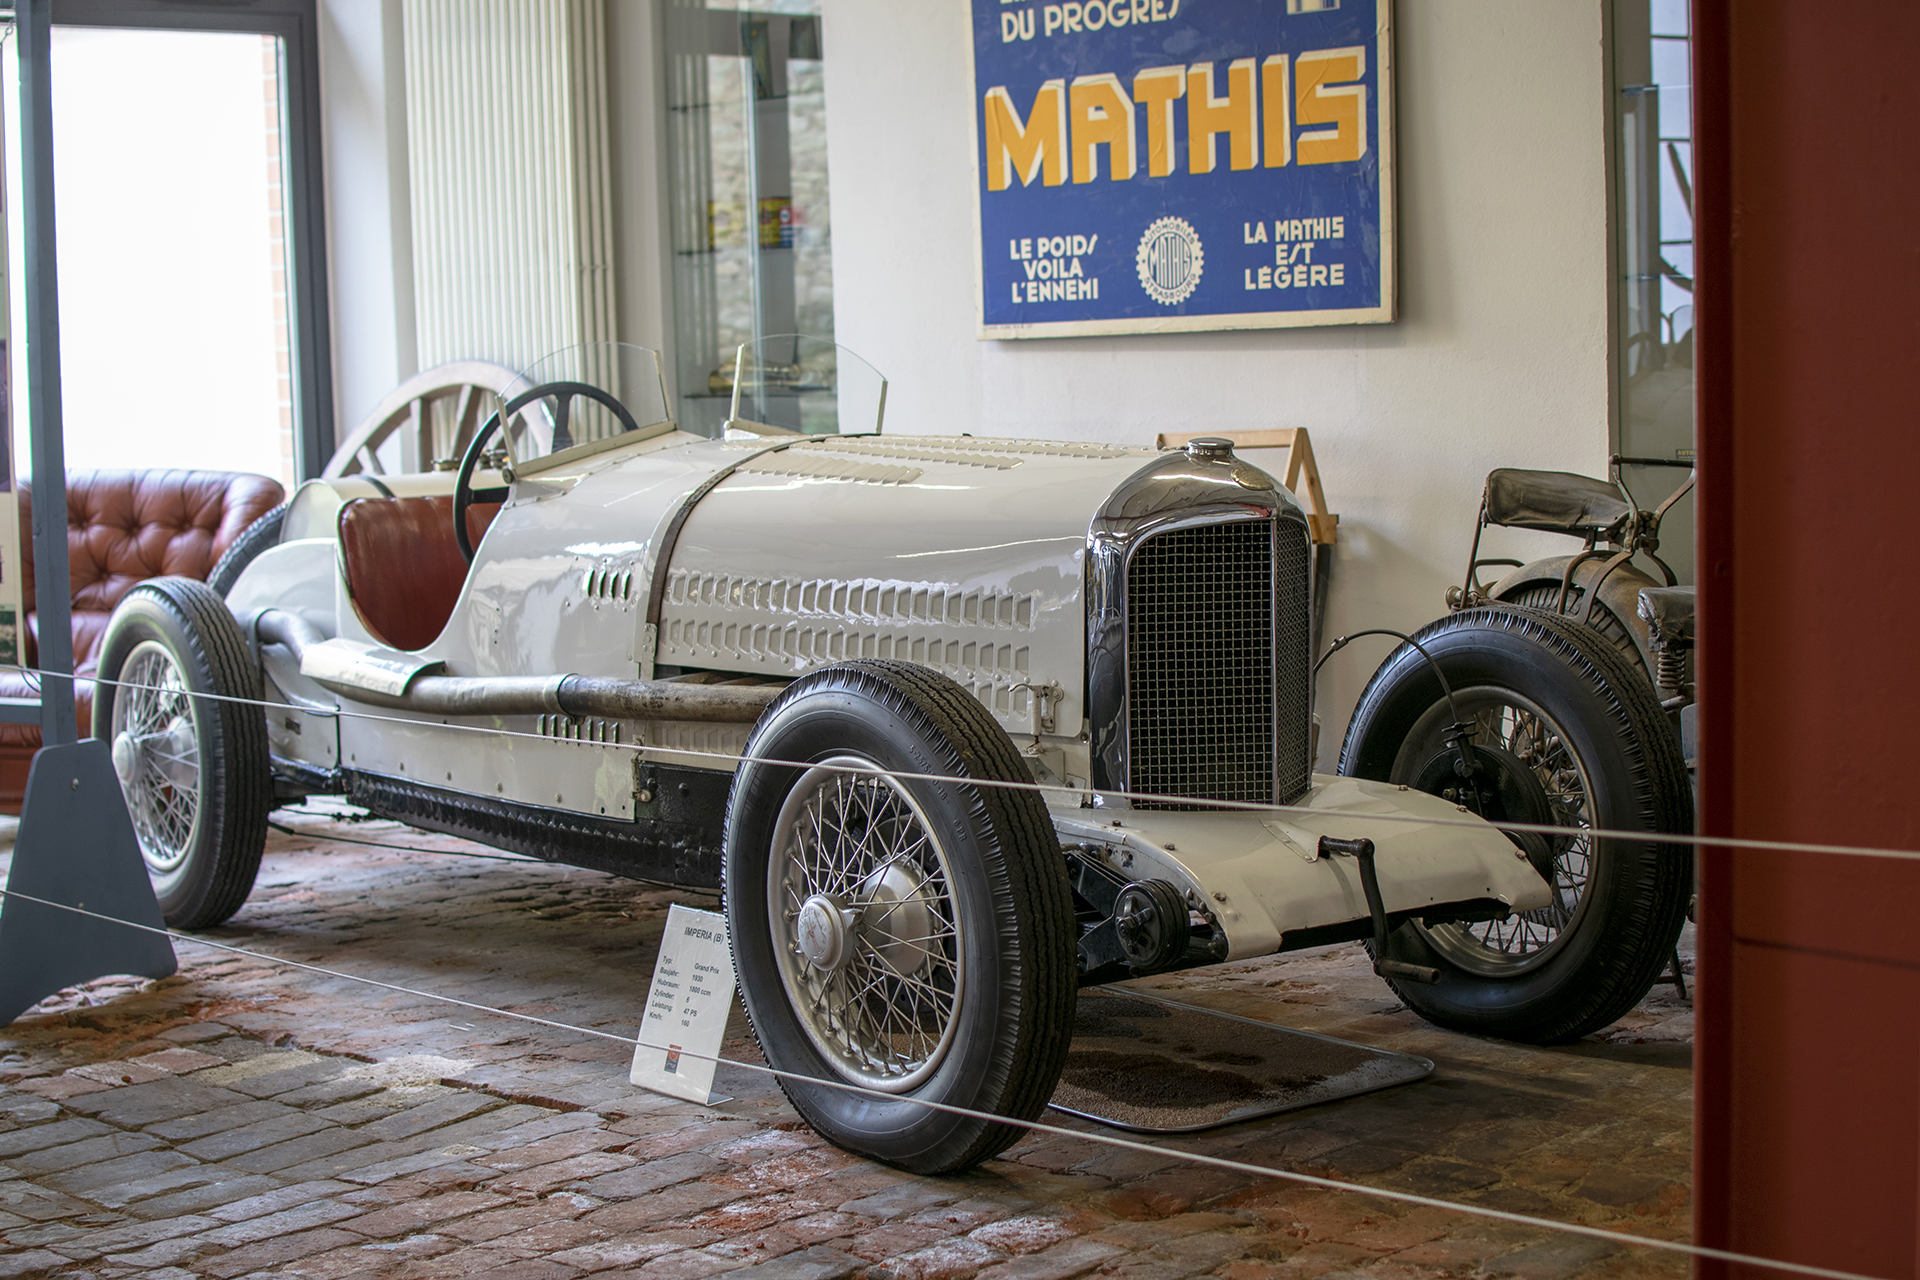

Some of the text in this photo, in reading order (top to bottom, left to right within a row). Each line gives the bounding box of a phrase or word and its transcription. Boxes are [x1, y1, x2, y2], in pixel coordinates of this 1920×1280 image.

[1001, 8, 1036, 43] DU
[984, 45, 1367, 191] MATHIS
[1144, 222, 1195, 249] AUTOMOBILES
[1244, 216, 1344, 244] LA MATHIS
[1010, 233, 1098, 260] LE POIDS
[1276, 242, 1315, 265] EST
[1023, 257, 1084, 280] VOILA
[1149, 233, 1191, 289] MATHIS
[1011, 277, 1099, 304] L'ENNEMI
[1144, 273, 1196, 299] STRASBOURG
[684, 926, 725, 945] IMPERIA (B)
[660, 966, 680, 977] Baujahr:
[694, 962, 709, 972] Grand
[709, 966, 720, 974] Prix
[654, 988, 675, 1000] Zylinder:
[657, 978, 680, 989] Hubraum:
[700, 989, 712, 997] ccm
[651, 1000, 673, 1012] Leistung:
[690, 1009, 698, 1018] PS
